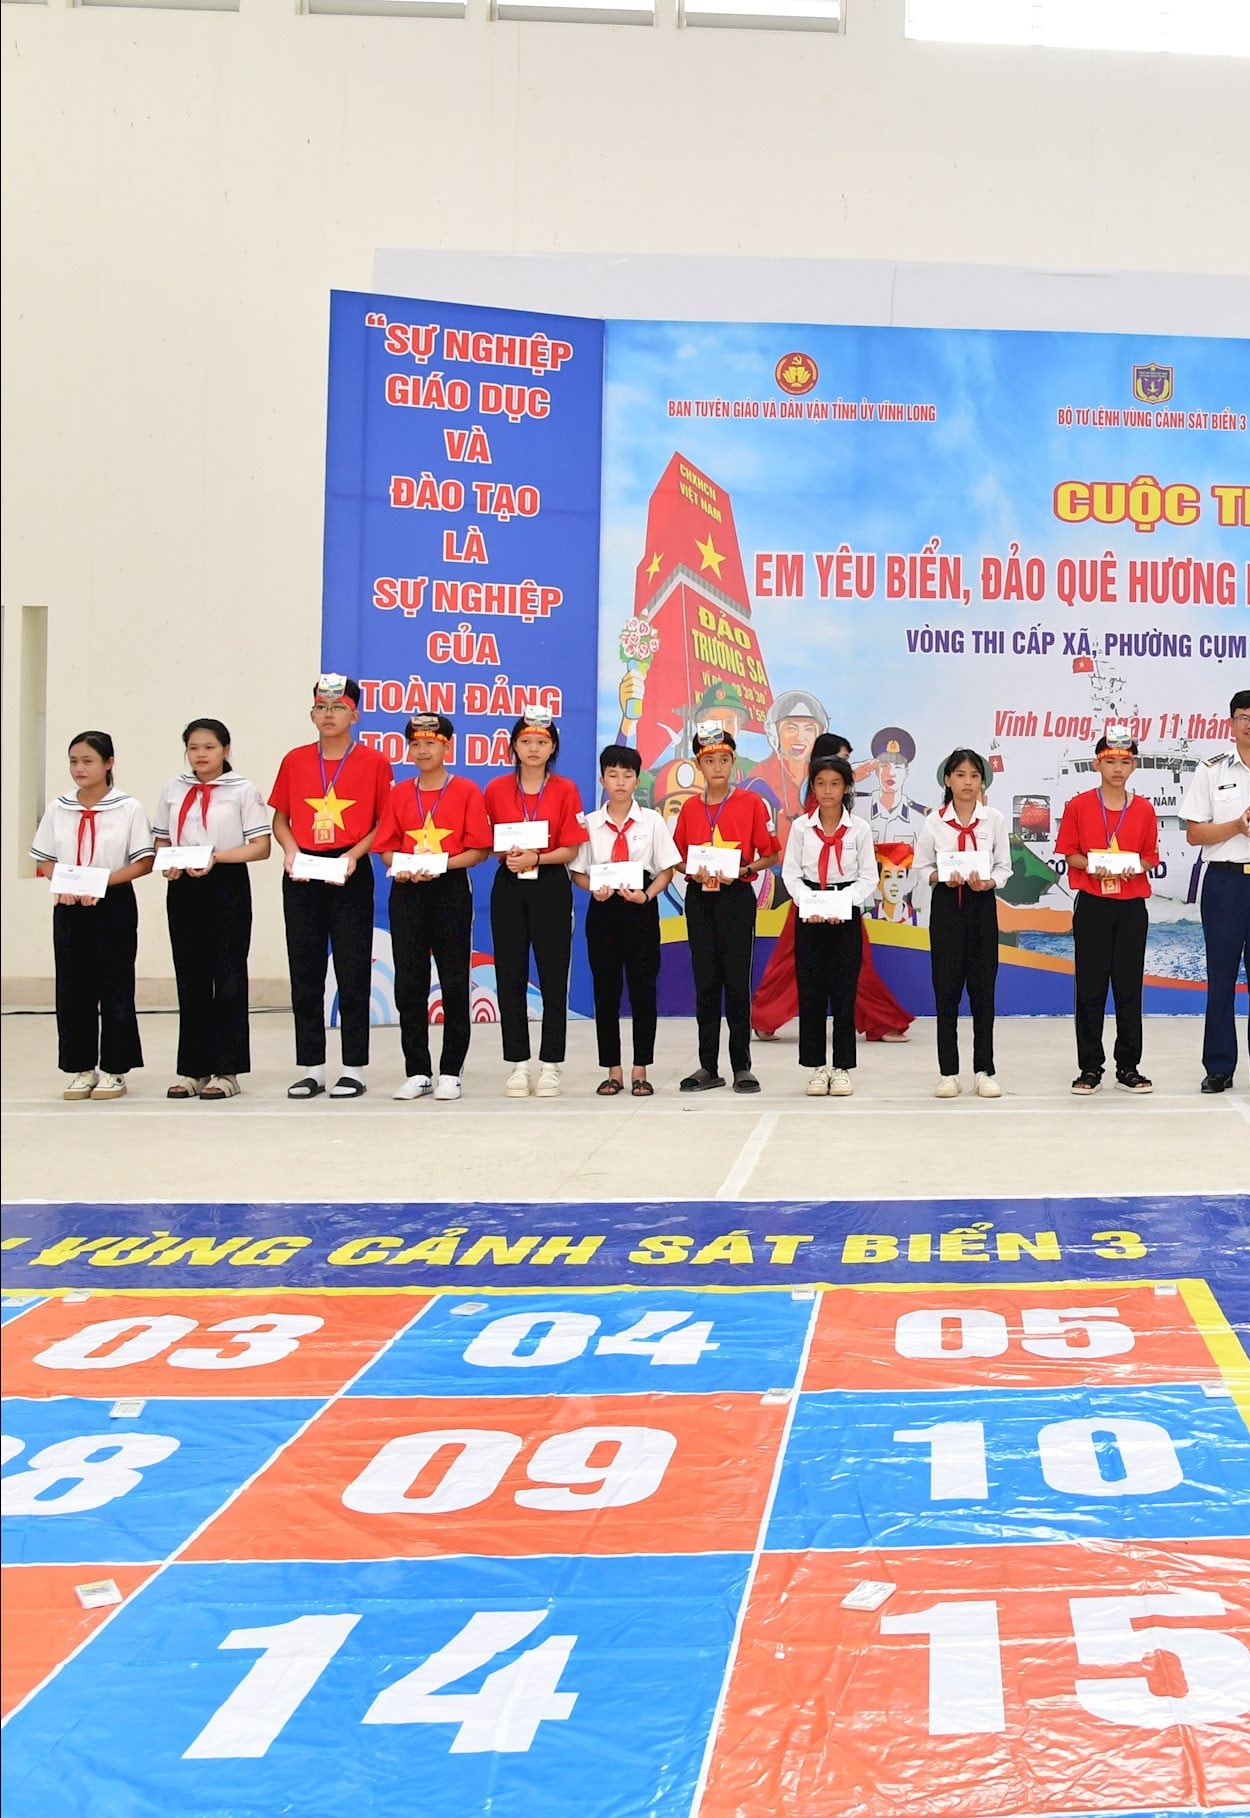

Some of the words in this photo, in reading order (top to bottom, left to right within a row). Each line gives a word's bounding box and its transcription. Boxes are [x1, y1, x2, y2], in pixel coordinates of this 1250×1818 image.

[445, 333, 572, 375] NGHIỆP
[386, 372, 470, 411] GIÁO
[480, 383, 550, 422] DỤC
[668, 400, 692, 417] BAN
[695, 398, 730, 418] TUYÊN
[733, 399, 760, 419] GIÁO
[762, 399, 777, 419] VÀ
[780, 398, 803, 420] DÂN
[806, 397, 829, 423] VẬN
[831, 397, 857, 420] TỈNH
[860, 397, 875, 421] ỦY
[878, 400, 904, 422] VĨNH
[907, 404, 936, 422] LONG
[1058, 406, 1073, 430] BỘ
[1076, 408, 1091, 426] TƯ
[1092, 406, 1120, 430] LỆNH
[1123, 408, 1152, 428] VÙNG
[1155, 406, 1185, 429] CẢNH
[1188, 409, 1209, 430] SÁT
[1211, 406, 1237, 431] BIỂN
[1239, 415, 1247, 431] 3
[444, 426, 492, 464] VÀ
[390, 472, 464, 511] ĐÀO
[472, 484, 540, 520] TẠO
[700, 497, 722, 524] NAM
[1054, 475, 1200, 532] CUỘC
[443, 526, 488, 563] LÀ
[754, 552, 804, 599] EM
[815, 542, 877, 601] YÊU
[885, 535, 972, 606] BIỂN,
[981, 543, 1046, 603] ĐẢO
[1056, 551, 1117, 607] QUÊ
[1129, 556, 1236, 607] HƯƠNG
[374, 577, 427, 617] SỰ
[433, 580, 563, 622] NGHIỆP
[428, 623, 500, 665] CỦA
[698, 605, 751, 650] ĐẢO
[905, 623, 966, 655] VÒNG
[971, 629, 1006, 657] THI
[1012, 624, 1055, 657] CẤP
[1061, 626, 1098, 659] XÃ,
[1104, 629, 1193, 659] PHƯỜNG
[1199, 632, 1248, 664] CỤM
[746, 655, 769, 687] SA
[360, 675, 455, 714] TOÀN
[464, 675, 562, 717] ĐẢNG
[994, 710, 1037, 738] Vĩnh
[1042, 713, 1096, 742] Long,
[1158, 714, 1180, 739] 11
[1153, 796, 1177, 806] NAM
[28, 1229, 312, 1267] VÙNG
[328, 1226, 605, 1267] CẢNH
[628, 1229, 813, 1267] SÁT
[842, 1221, 1077, 1264] BIỂN
[1090, 1230, 1148, 1261] 3
[33, 1313, 324, 1370] 03
[462, 1310, 720, 1368] 04
[895, 1306, 1135, 1360] 05
[1, 1432, 181, 1517] 8
[342, 1426, 678, 1515] 09
[893, 1416, 1185, 1501] 10
[180, 1609, 580, 1760] 14
